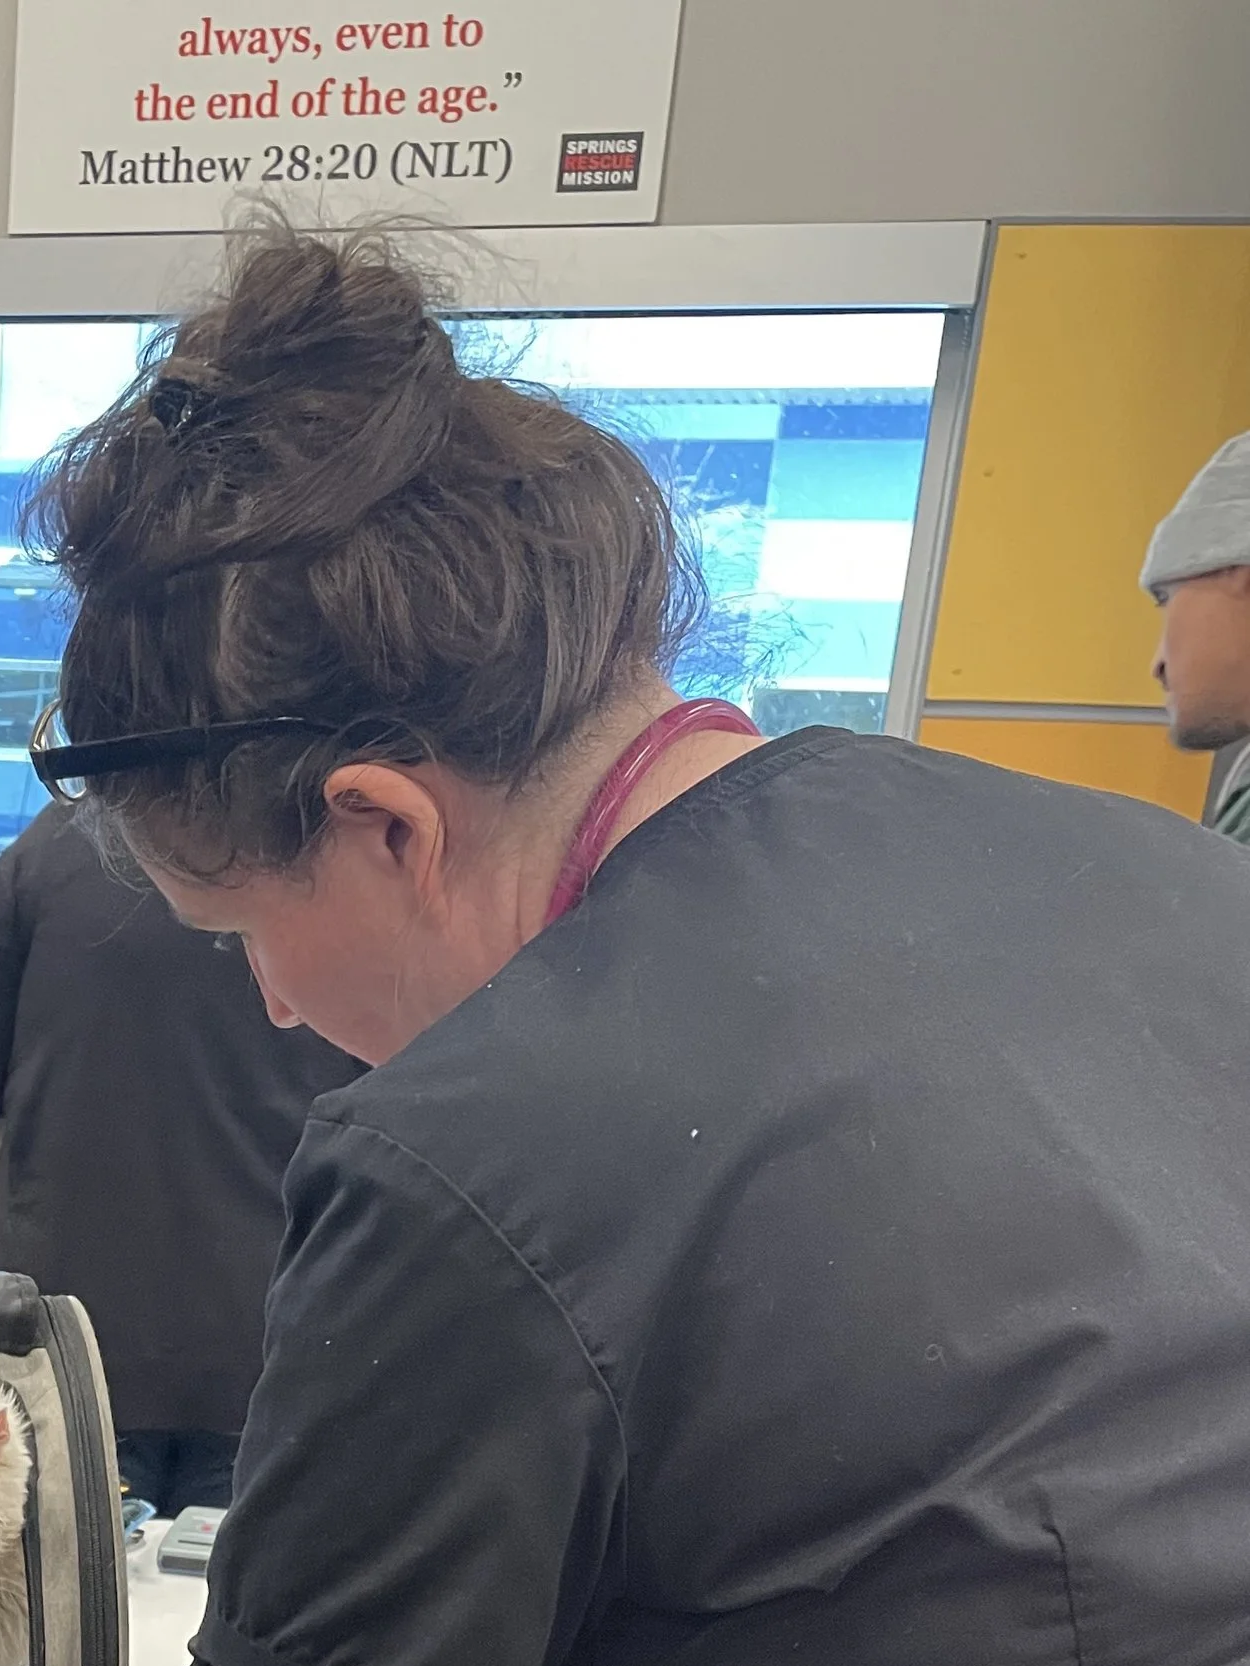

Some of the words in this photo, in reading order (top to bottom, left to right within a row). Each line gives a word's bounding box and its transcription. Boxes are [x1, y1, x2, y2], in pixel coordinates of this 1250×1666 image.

[178, 16, 322, 64] always,
[335, 21, 430, 52] even
[442, 13, 484, 48] to
[134, 83, 196, 122] the
[206, 79, 280, 120] end
[291, 77, 337, 118] of
[341, 76, 406, 117] the
[417, 71, 523, 124] age.”
[78, 145, 252, 186] Matthew
[261, 143, 378, 182] 28:20
[390, 137, 513, 186] (NLT)
[564, 154, 636, 170] RESCUE
[566, 139, 638, 154] SPRINGS
[562, 170, 635, 185] MISSION
